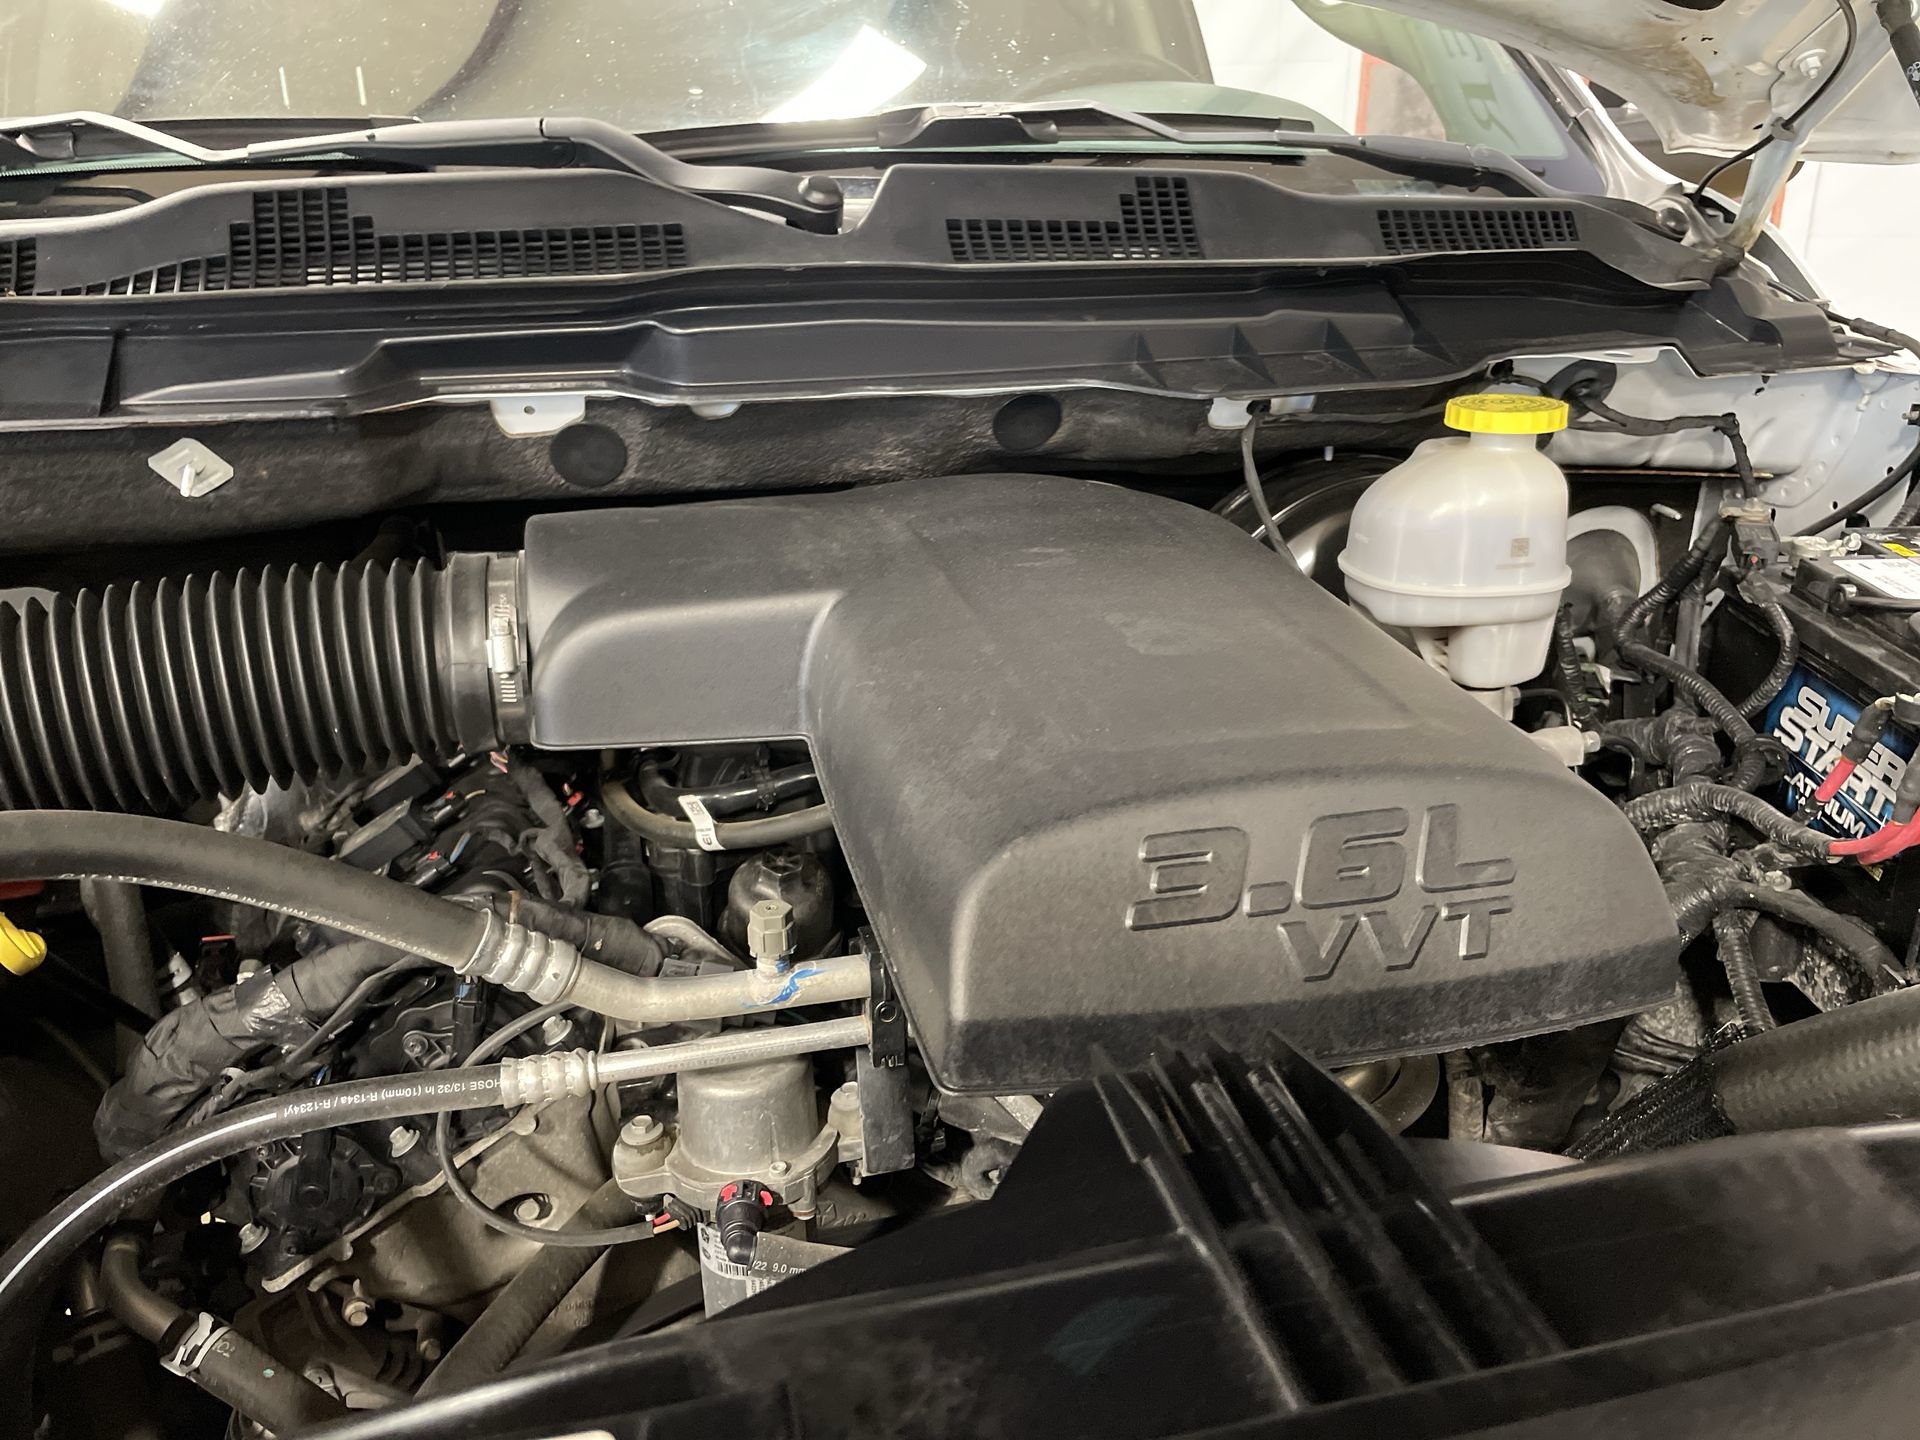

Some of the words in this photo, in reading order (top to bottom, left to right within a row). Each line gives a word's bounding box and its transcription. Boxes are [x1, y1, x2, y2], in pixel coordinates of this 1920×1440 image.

[1125, 803, 1516, 931] 3.6L
[1276, 896, 1513, 982] VVT
[381, 1083, 422, 1100] (10mm)
[437, 1082, 466, 1095] 13/32
[333, 1096, 339, 1108] /
[340, 1091, 378, 1104] R-134a
[284, 1099, 331, 1118] R-1234yf
[772, 1263, 788, 1274] 9.0
